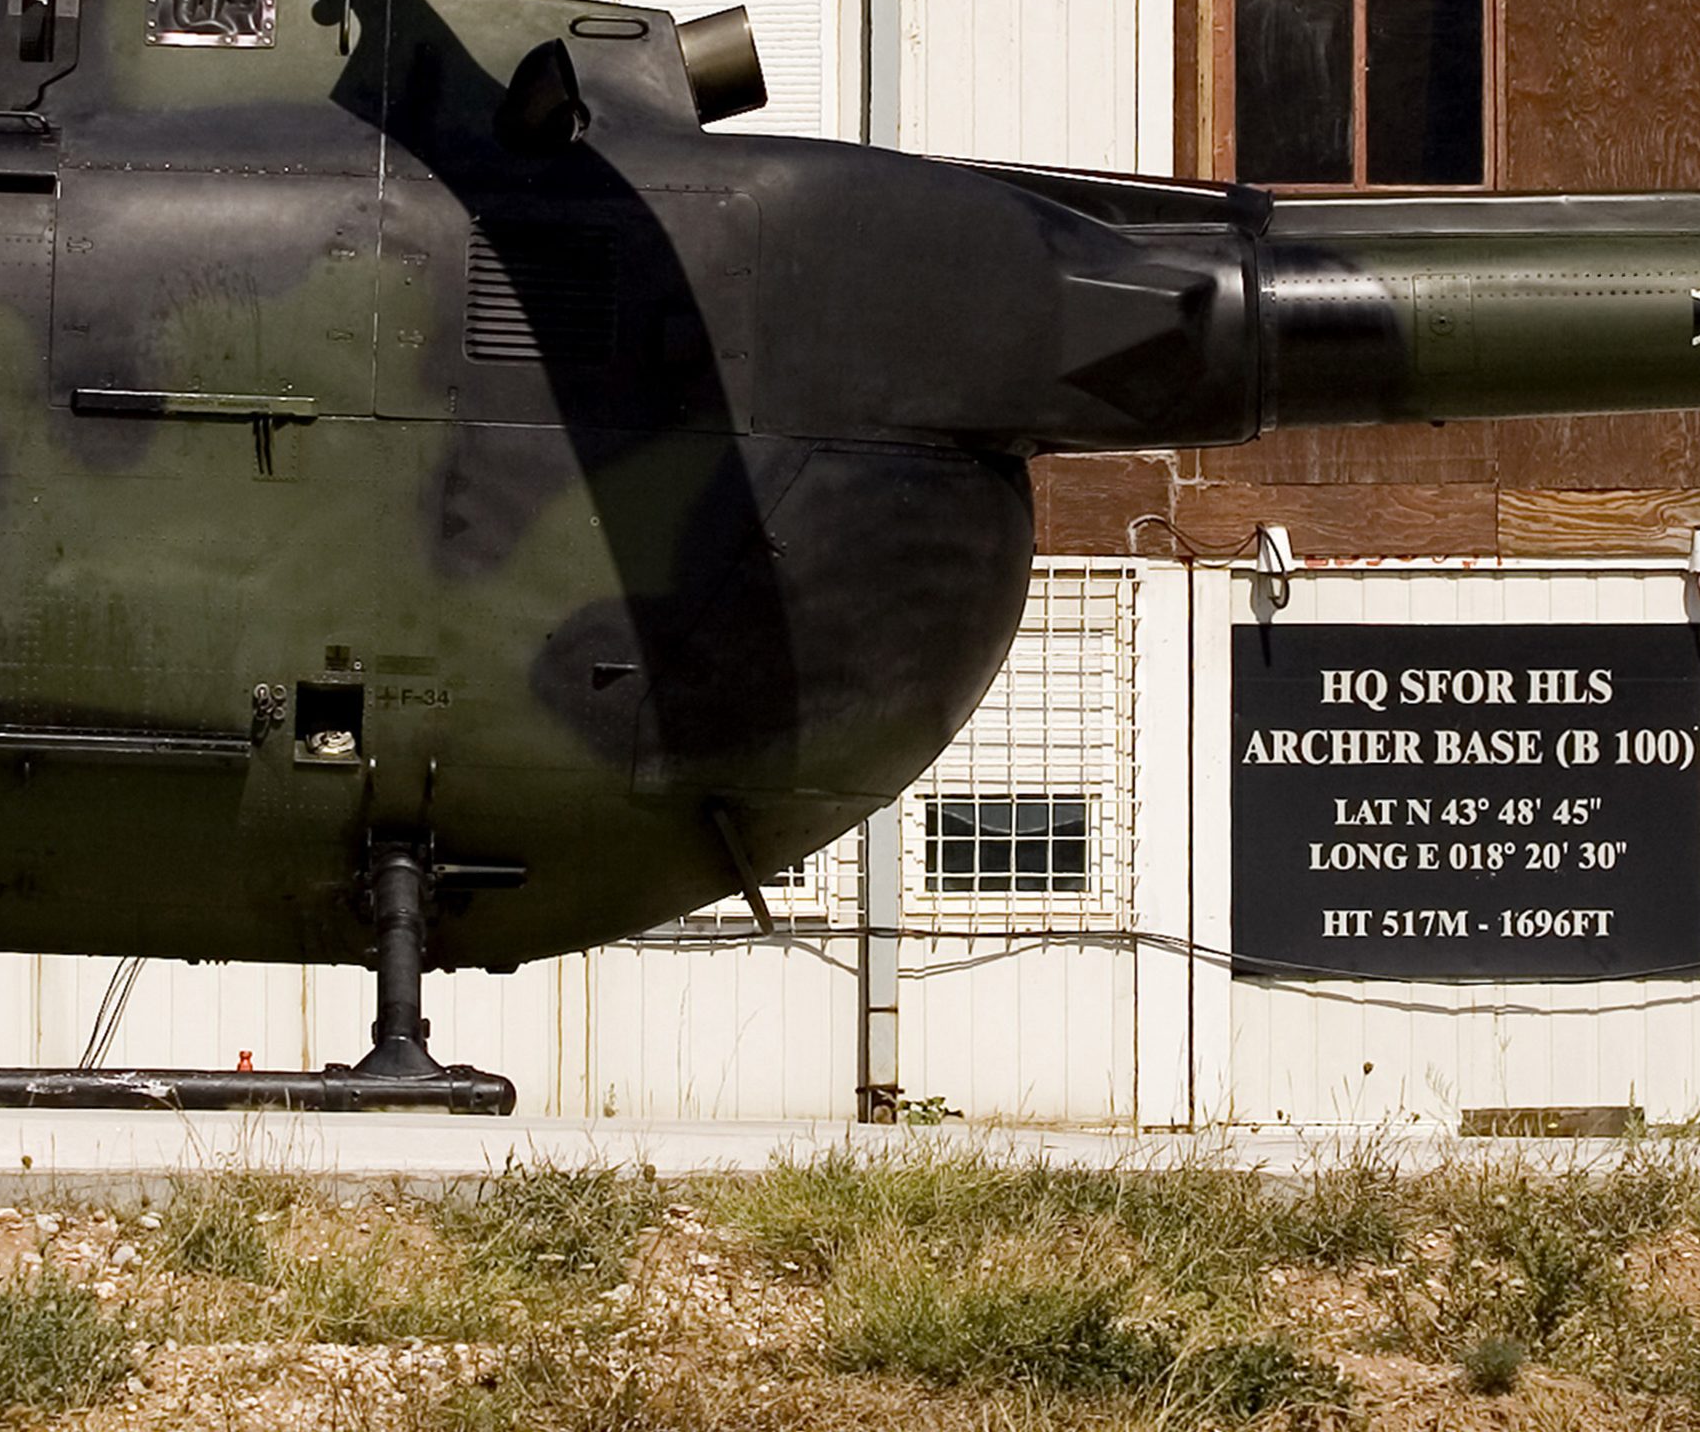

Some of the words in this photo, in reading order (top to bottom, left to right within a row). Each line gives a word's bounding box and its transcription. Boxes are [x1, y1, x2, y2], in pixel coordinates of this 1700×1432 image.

[401, 689, 449, 706] F-34
[1321, 670, 1387, 711] HQ
[1401, 669, 1516, 703] SFOR
[1527, 670, 1612, 703] HLS
[1242, 730, 1423, 764] ARCHER
[1434, 730, 1542, 764] BASE
[1557, 730, 1599, 768] (B
[1616, 730, 1694, 770] 100)
[1335, 799, 1397, 825] LAT
[1407, 799, 1432, 825] N
[1441, 798, 1489, 825] 43°
[1498, 798, 1540, 825] 48'
[1553, 798, 1601, 824] 45"
[1309, 843, 1408, 869] LONG
[1417, 844, 1439, 869] E
[1450, 842, 1515, 869] 018°
[1525, 842, 1568, 869] 20'
[1579, 842, 1626, 869] 30"
[1322, 911, 1372, 936] HT
[1383, 911, 1468, 936] 517M
[1499, 910, 1613, 937] 1696FT
